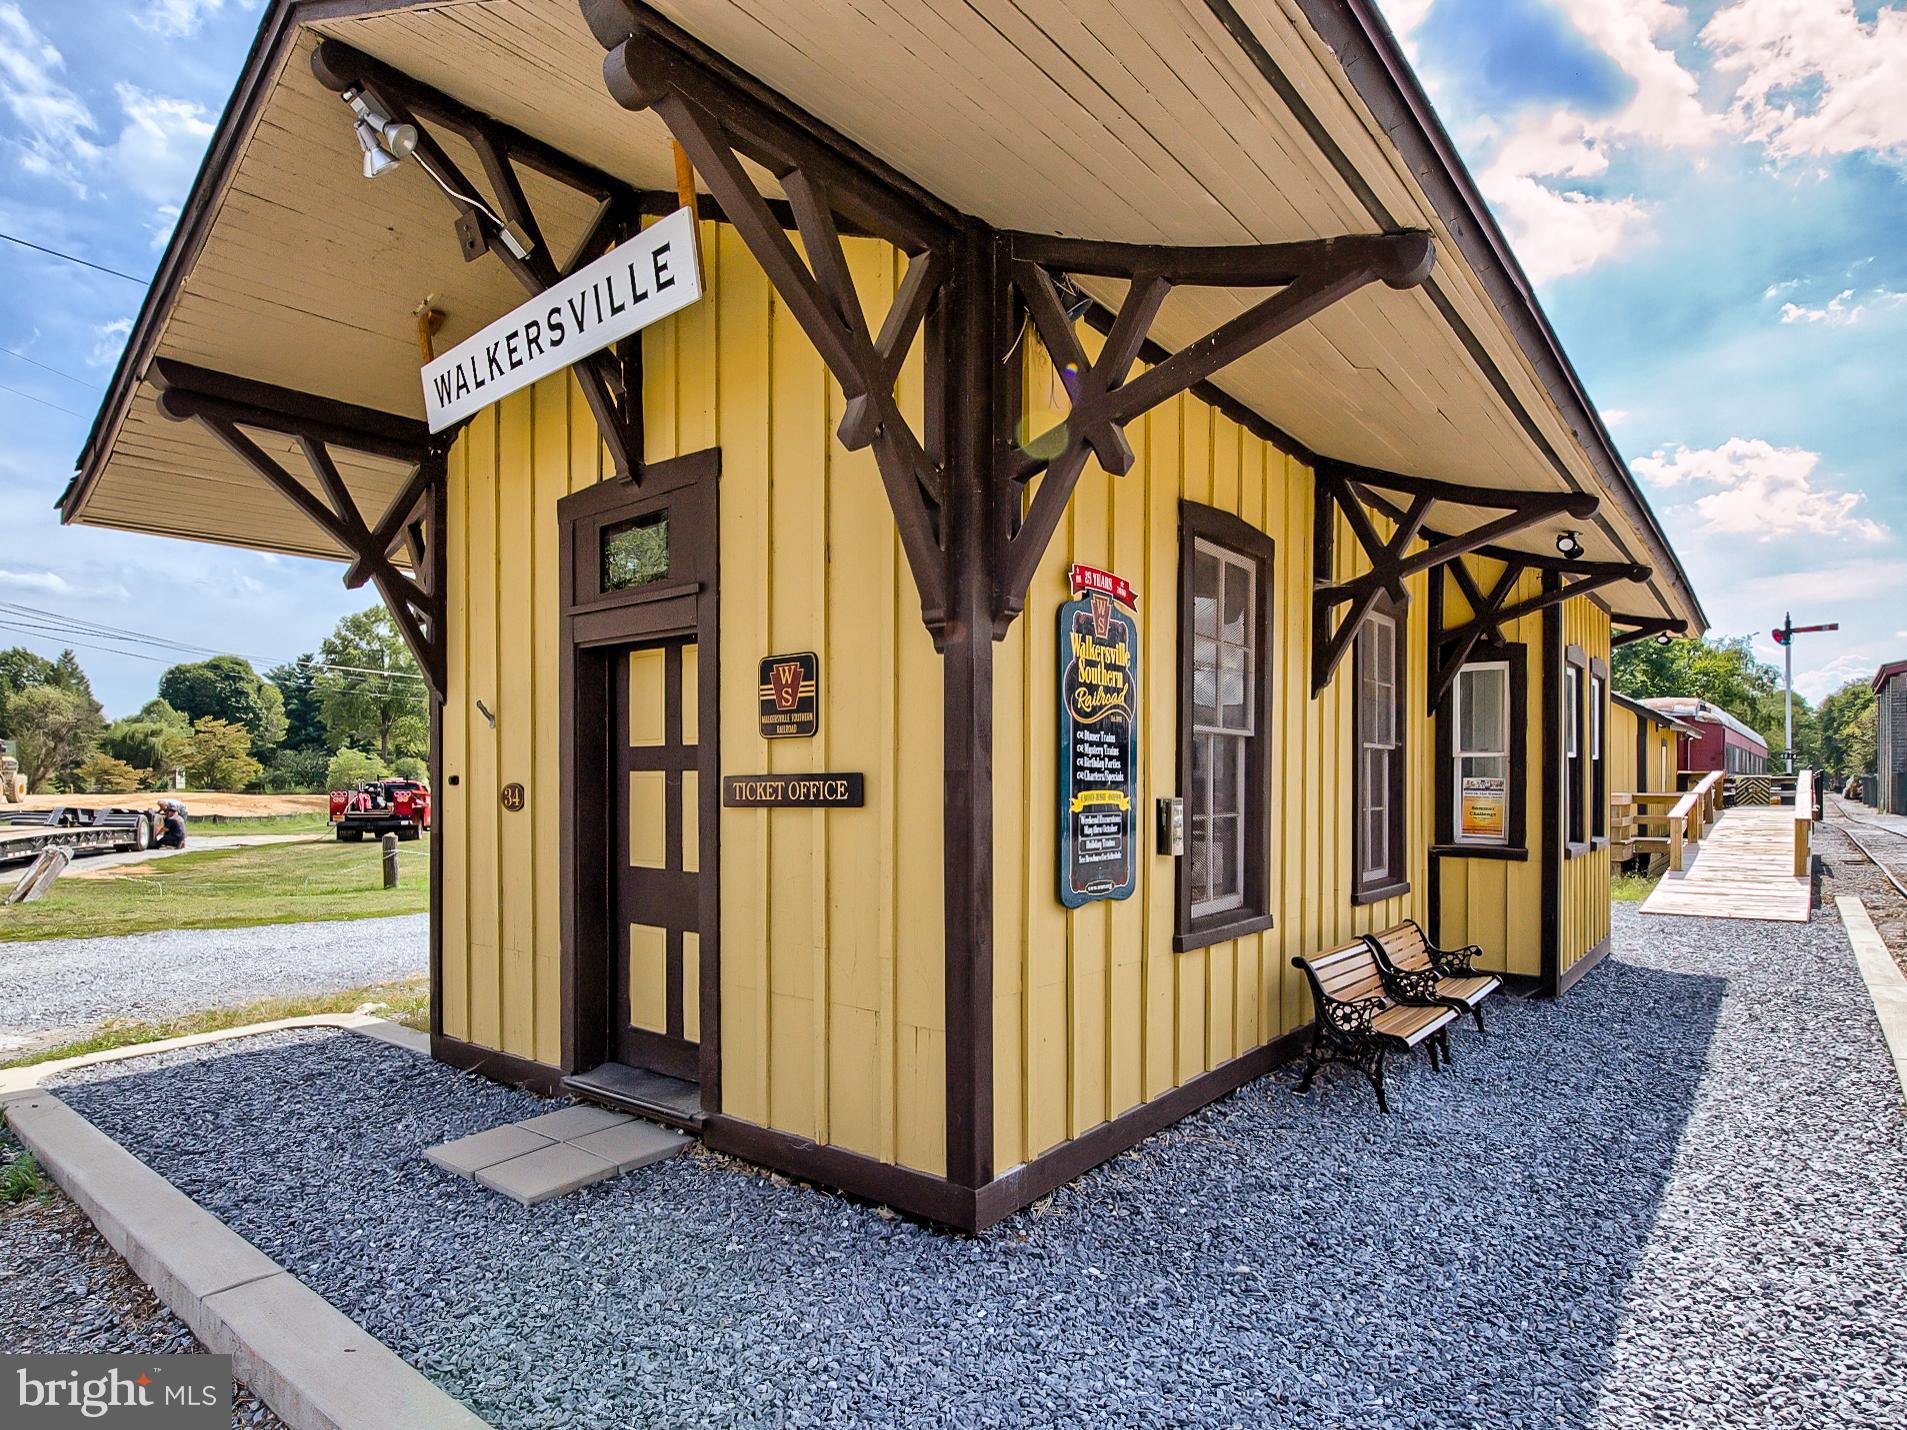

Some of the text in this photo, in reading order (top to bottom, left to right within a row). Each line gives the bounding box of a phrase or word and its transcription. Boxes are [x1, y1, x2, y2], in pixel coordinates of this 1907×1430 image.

[433, 240, 676, 409] WALKERSVILLE
[1093, 572, 1113, 592] YEARS
[1070, 631, 1131, 667] Walkersville
[778, 665, 796, 685] W
[1078, 657, 1124, 688] Southern
[781, 687, 792, 706] S
[1075, 683, 1129, 712] Railroad
[776, 724, 797, 734] RAILROAD
[1084, 730, 1116, 743] Dinner Trains
[1084, 743, 1119, 758] Mystery Trains
[1084, 756, 1121, 771] Birthday Parties
[504, 787, 521, 807] 34
[732, 780, 849, 801] TICKET OFFICE
